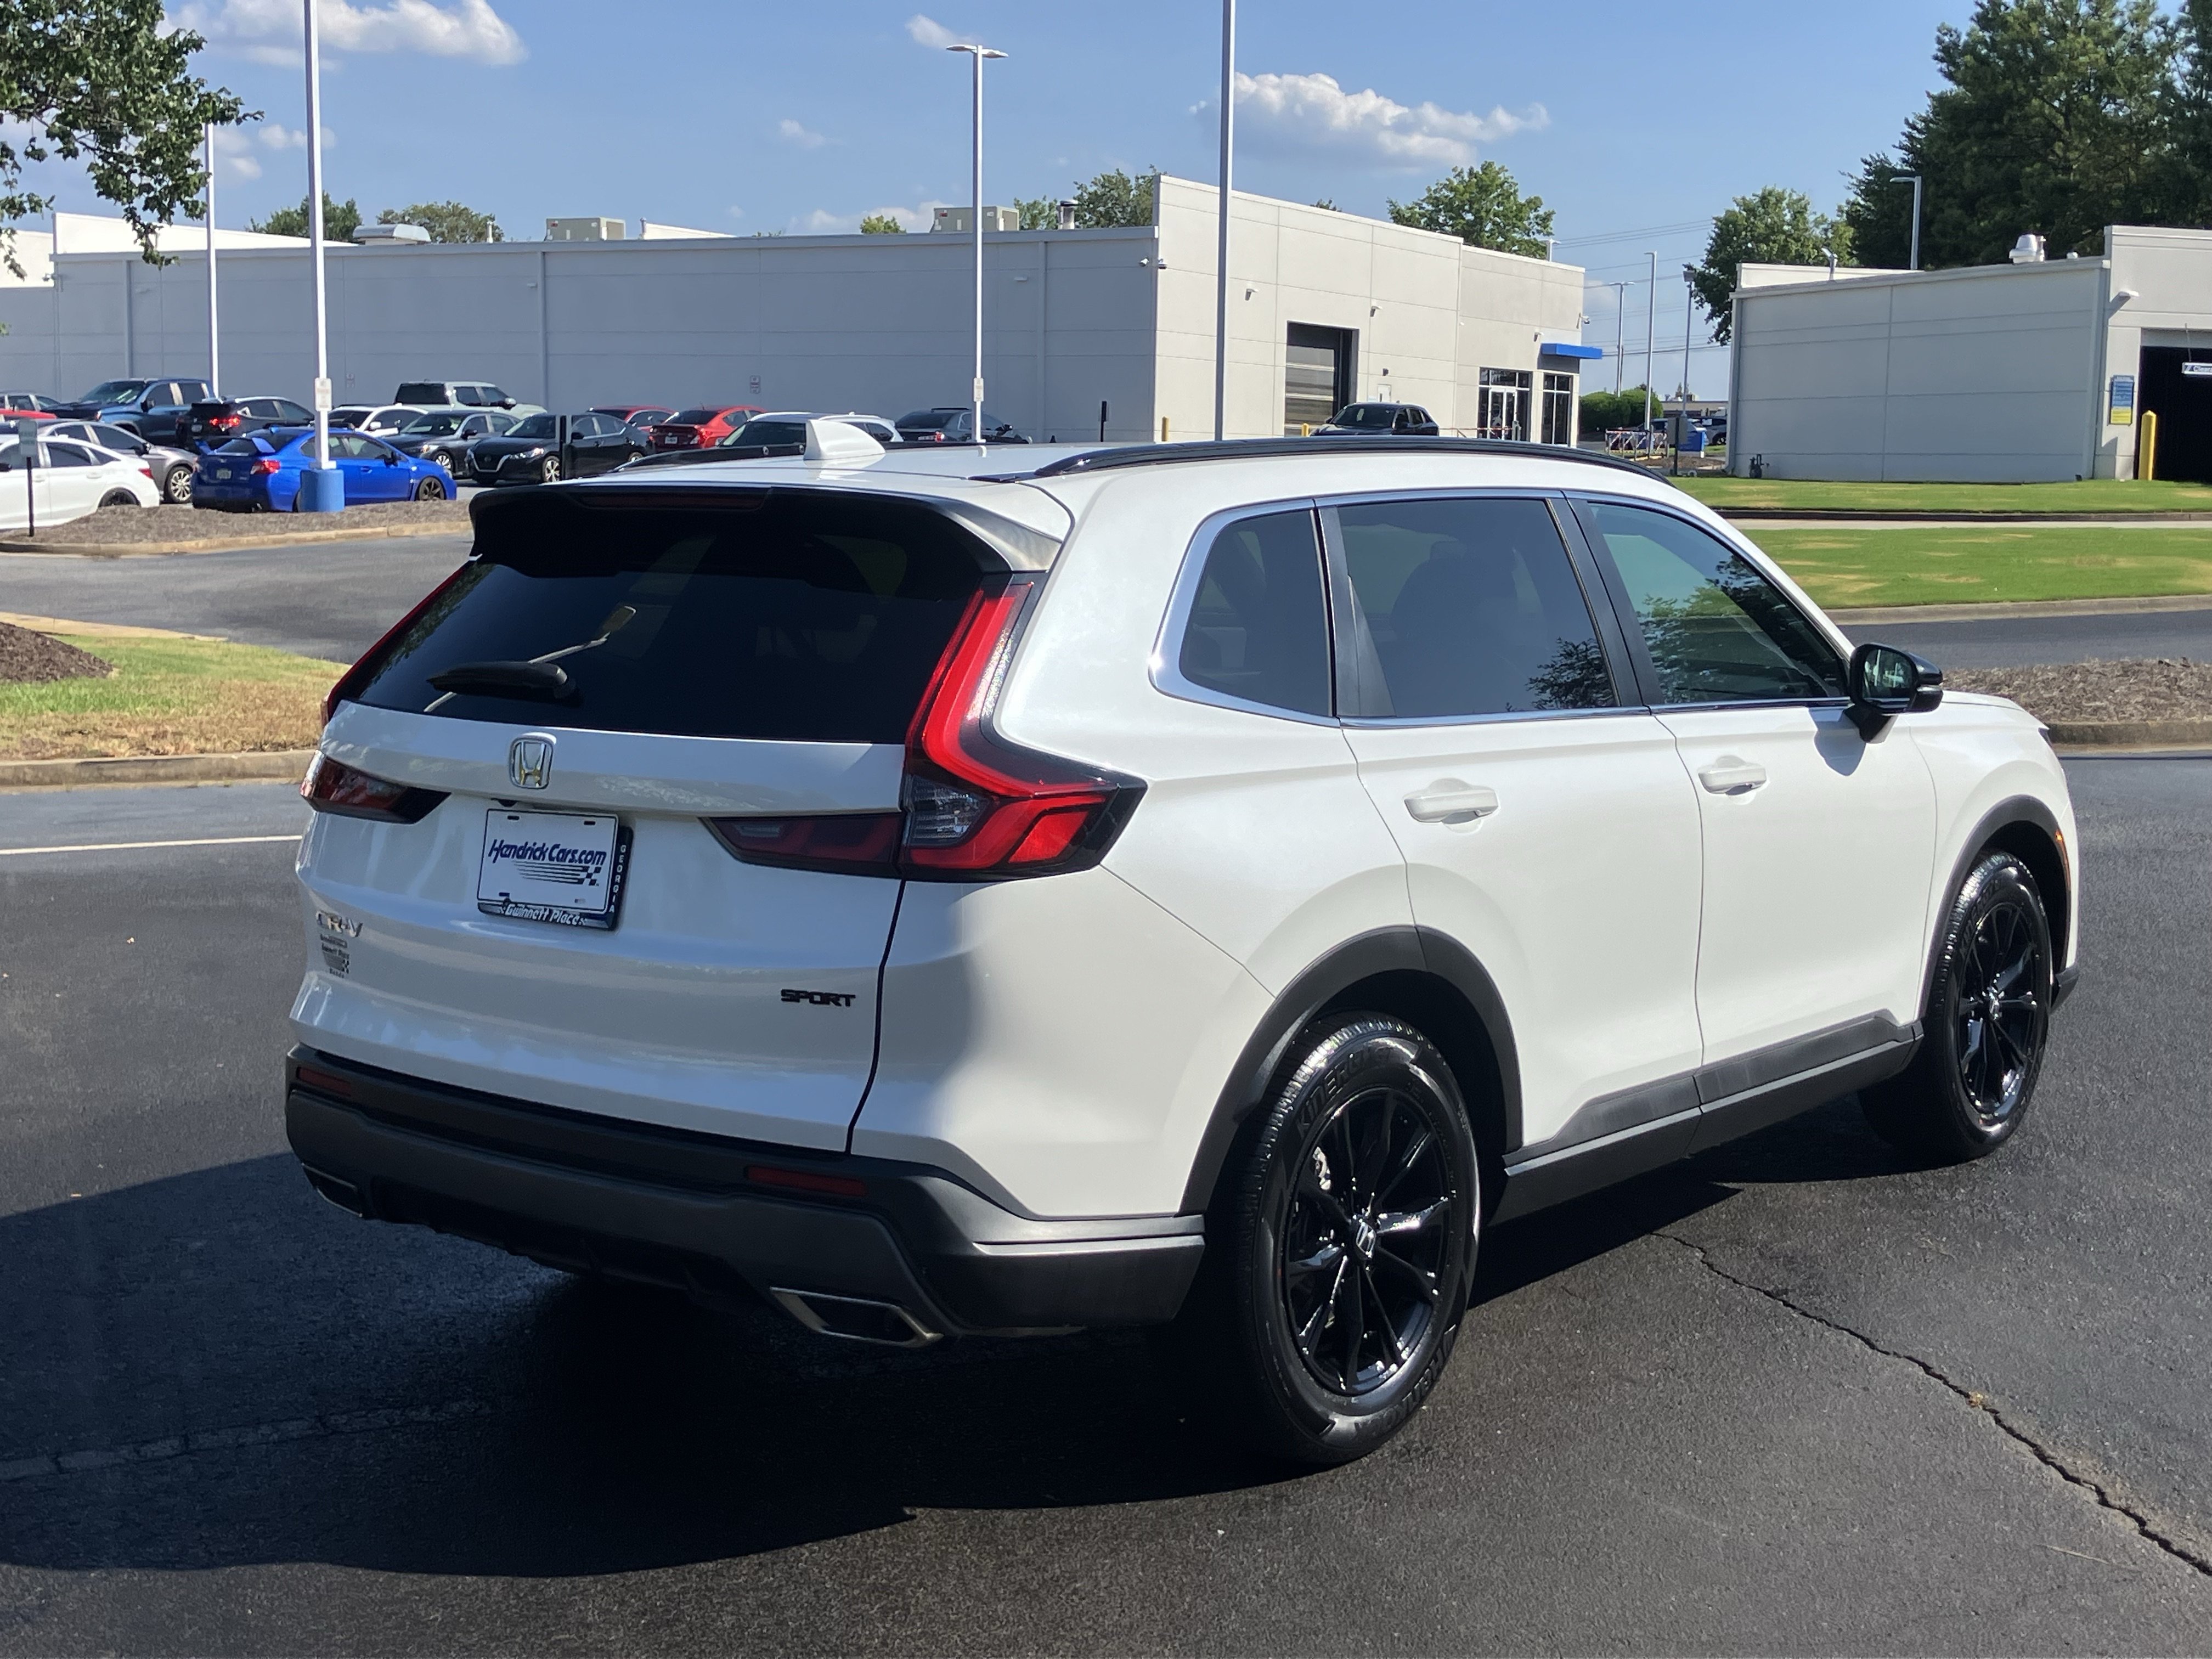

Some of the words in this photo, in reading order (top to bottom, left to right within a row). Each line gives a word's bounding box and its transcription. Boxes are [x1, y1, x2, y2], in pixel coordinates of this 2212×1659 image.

[609, 844, 627, 913] GEORGIA
[315, 910, 364, 938] CR-V
[505, 904, 549, 921] Gwinnett
[549, 908, 580, 926] Place
[781, 989, 856, 1007] SPORT
